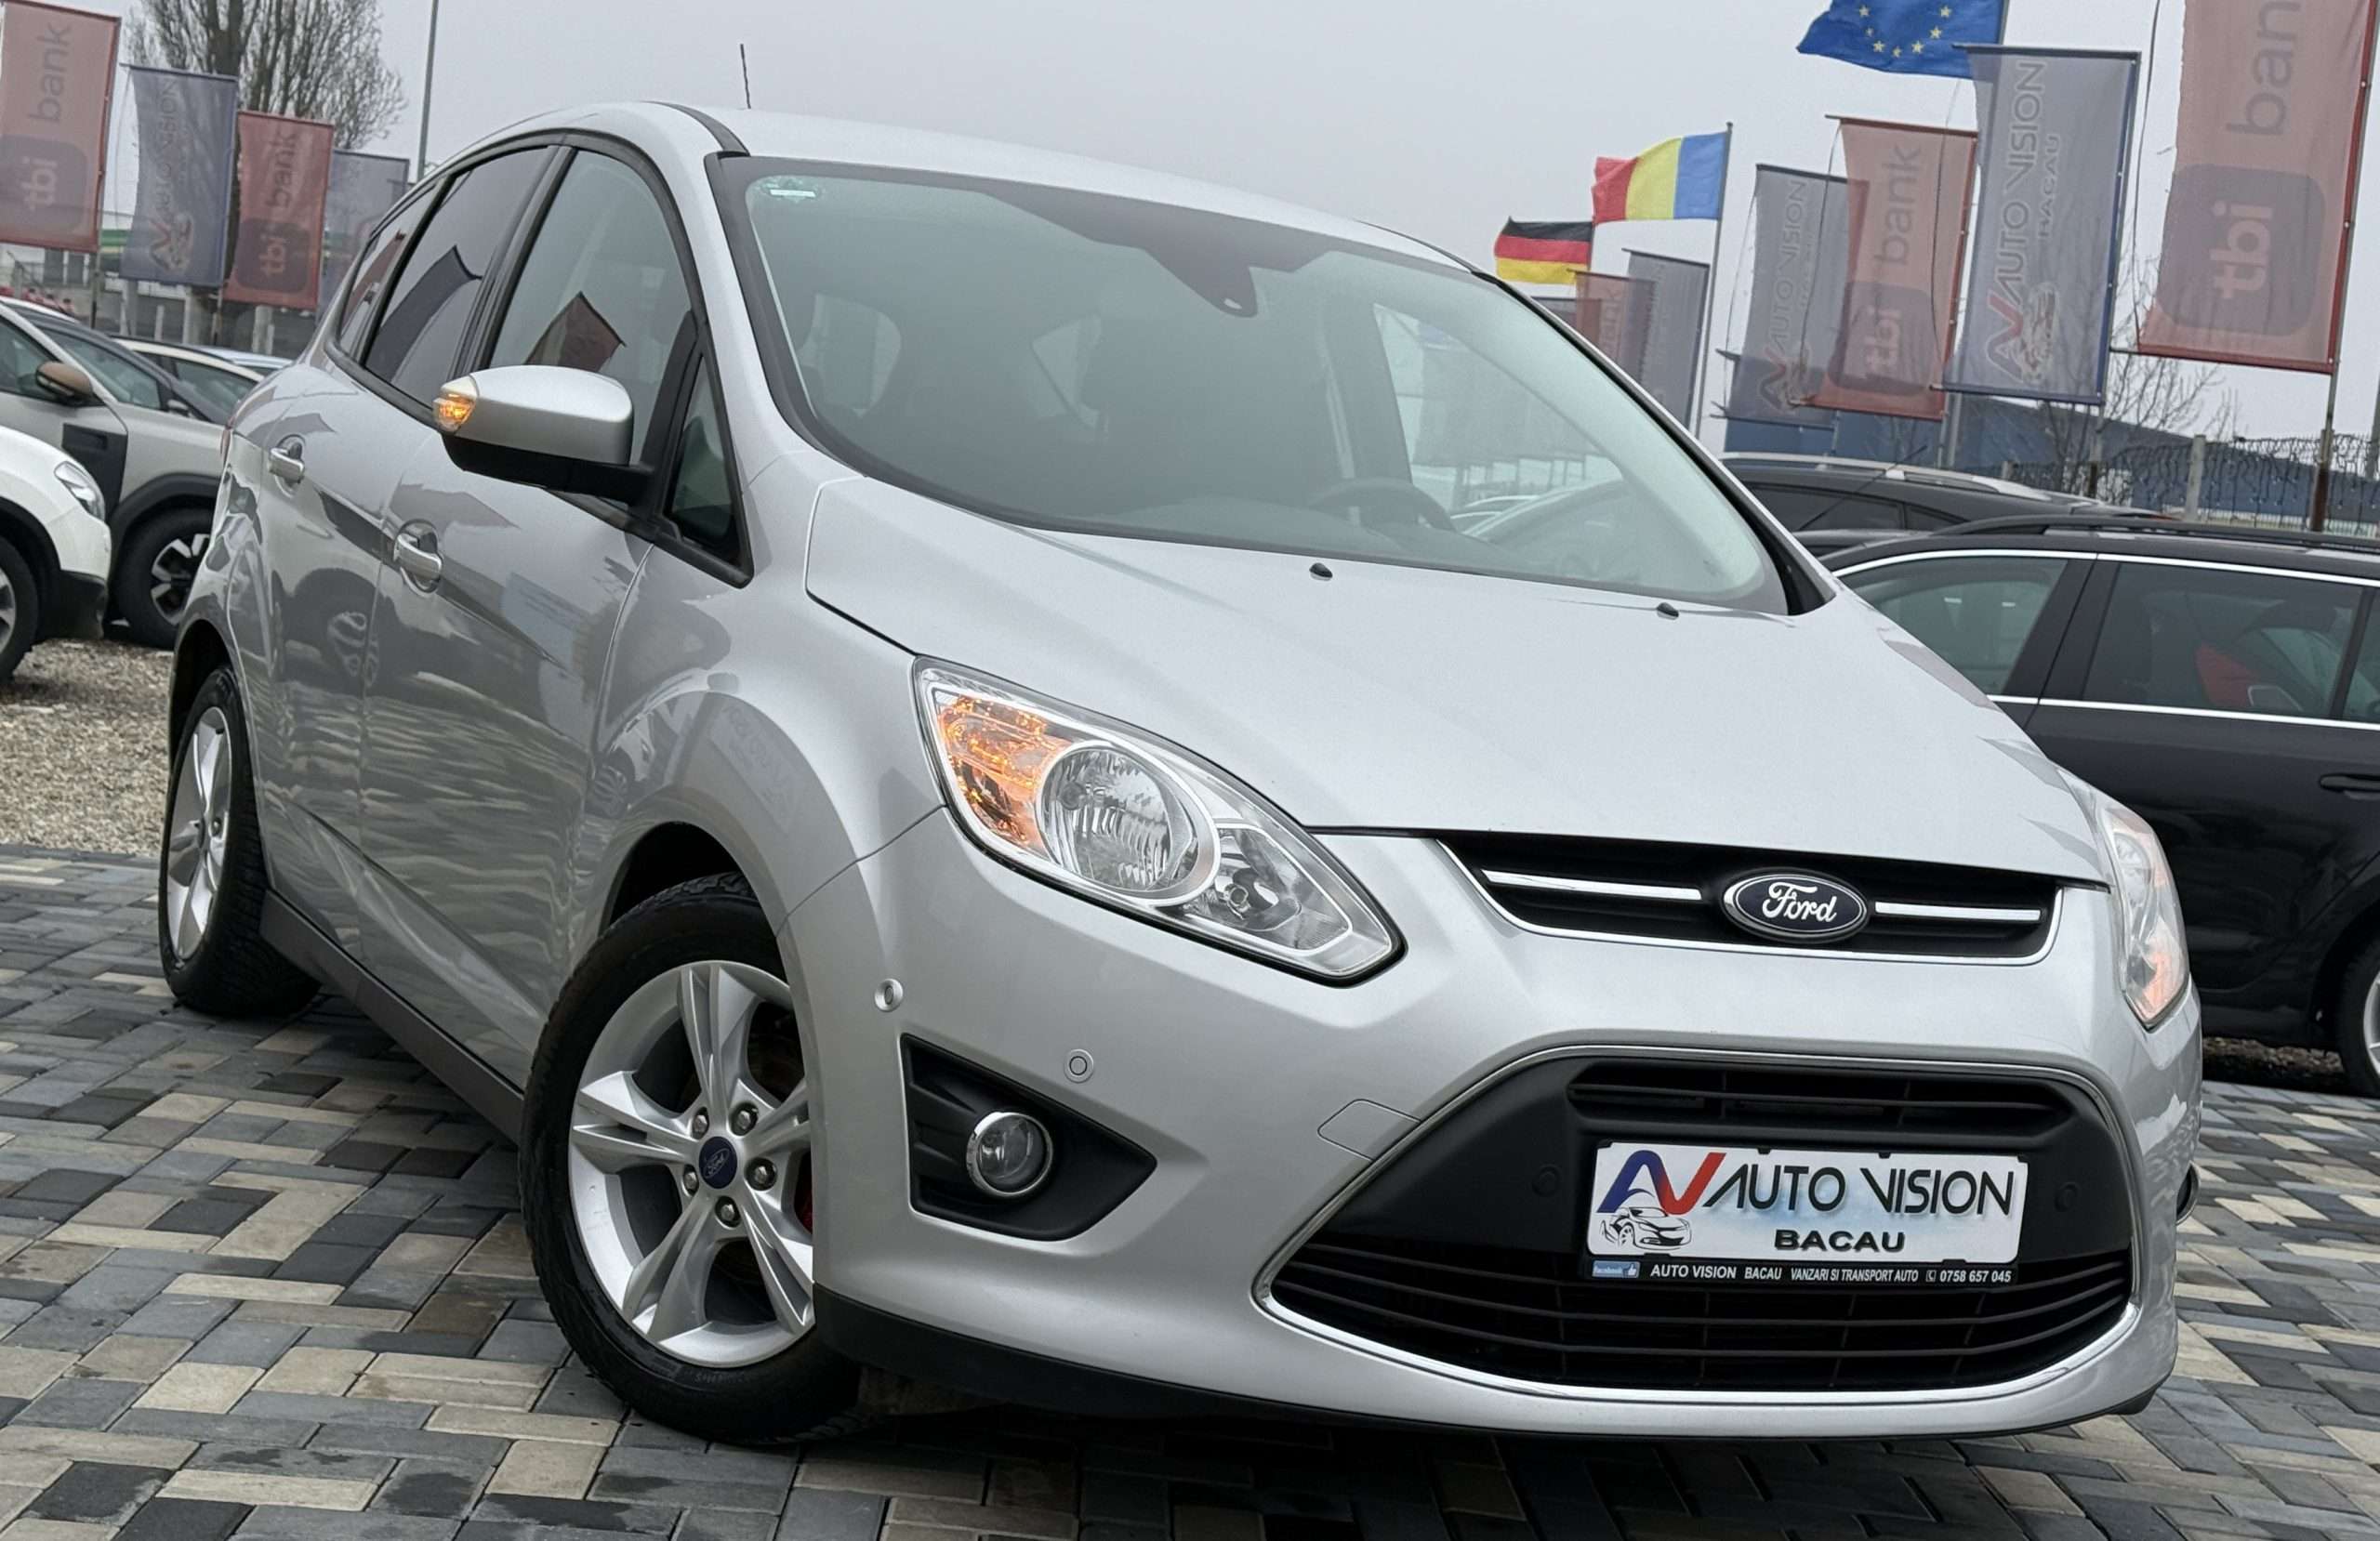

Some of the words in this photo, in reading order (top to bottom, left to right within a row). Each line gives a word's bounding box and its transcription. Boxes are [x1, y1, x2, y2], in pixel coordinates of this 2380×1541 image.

[28, 21, 72, 123] bank
[2226, 0, 2301, 137] ban
[265, 127, 296, 207] bank
[2006, 61, 2046, 191] VISION
[20, 155, 58, 211] tbi
[1776, 180, 1806, 270] VISION
[1874, 145, 1922, 267] bank
[1997, 201, 2030, 307] AUTO
[2210, 200, 2274, 299] tbi
[1769, 279, 1795, 351] AUTO
[1762, 882, 1838, 922] Ford
[1702, 1164, 1845, 1212] AUTO
[1859, 1167, 2015, 1216] VISION
[1650, 1264, 1690, 1278] AUTO
[1693, 1265, 1737, 1279] VISION
[1744, 1267, 1782, 1280] BACAU
[1791, 1267, 1829, 1281] VANZARI
[1830, 1268, 1840, 1281] SI
[1842, 1269, 1894, 1282] TRANSPORT
[1894, 1269, 1919, 1282] AUTO
[1939, 1270, 1966, 1283] 0758
[1969, 1270, 1990, 1283] 657
[1991, 1270, 2012, 1283] 045
[1774, 1229, 1906, 1253] BACAU
